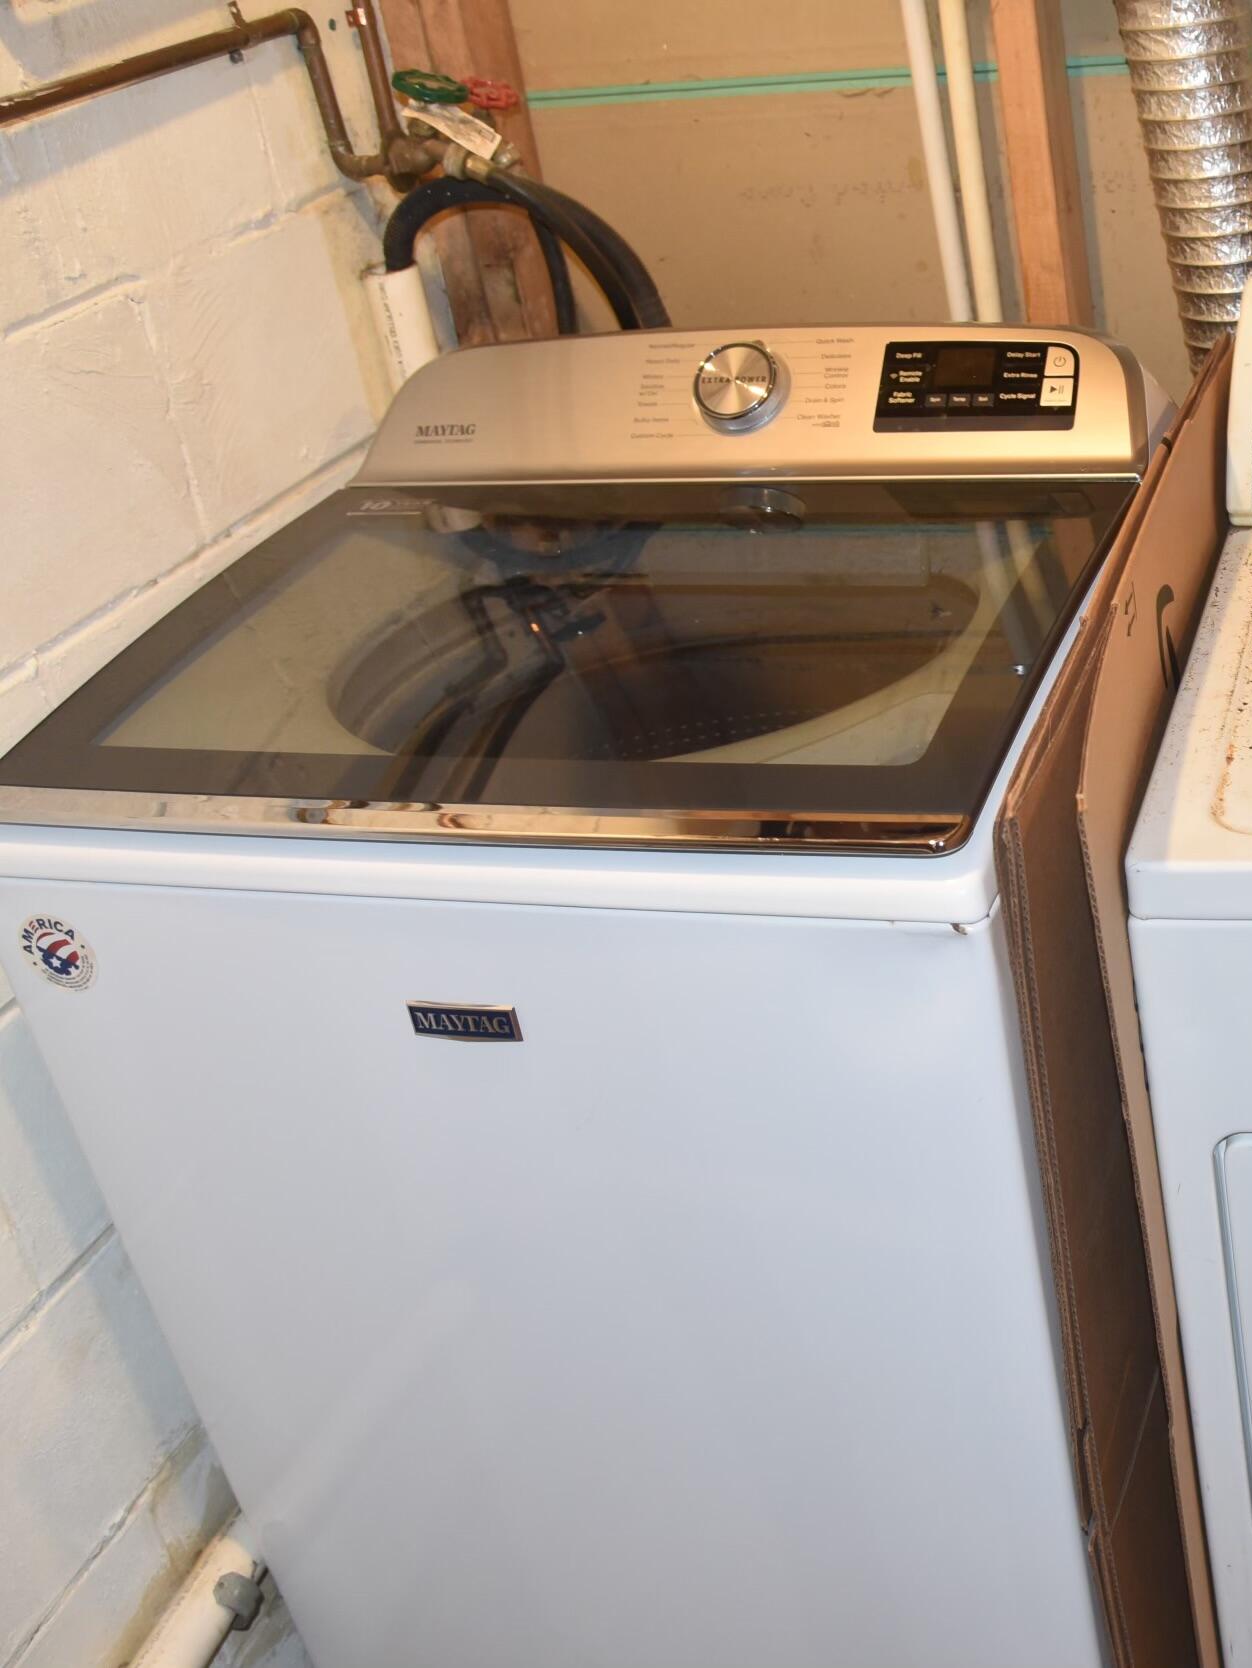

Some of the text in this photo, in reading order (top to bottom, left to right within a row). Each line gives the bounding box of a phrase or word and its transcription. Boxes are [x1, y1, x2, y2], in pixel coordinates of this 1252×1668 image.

[701, 374, 768, 385] EXTRA POWER
[1018, 392, 1037, 400] Signal
[415, 423, 477, 438] MAYTAG
[21, 918, 76, 956] AMERICA
[414, 1011, 511, 1034] MAYTAG
